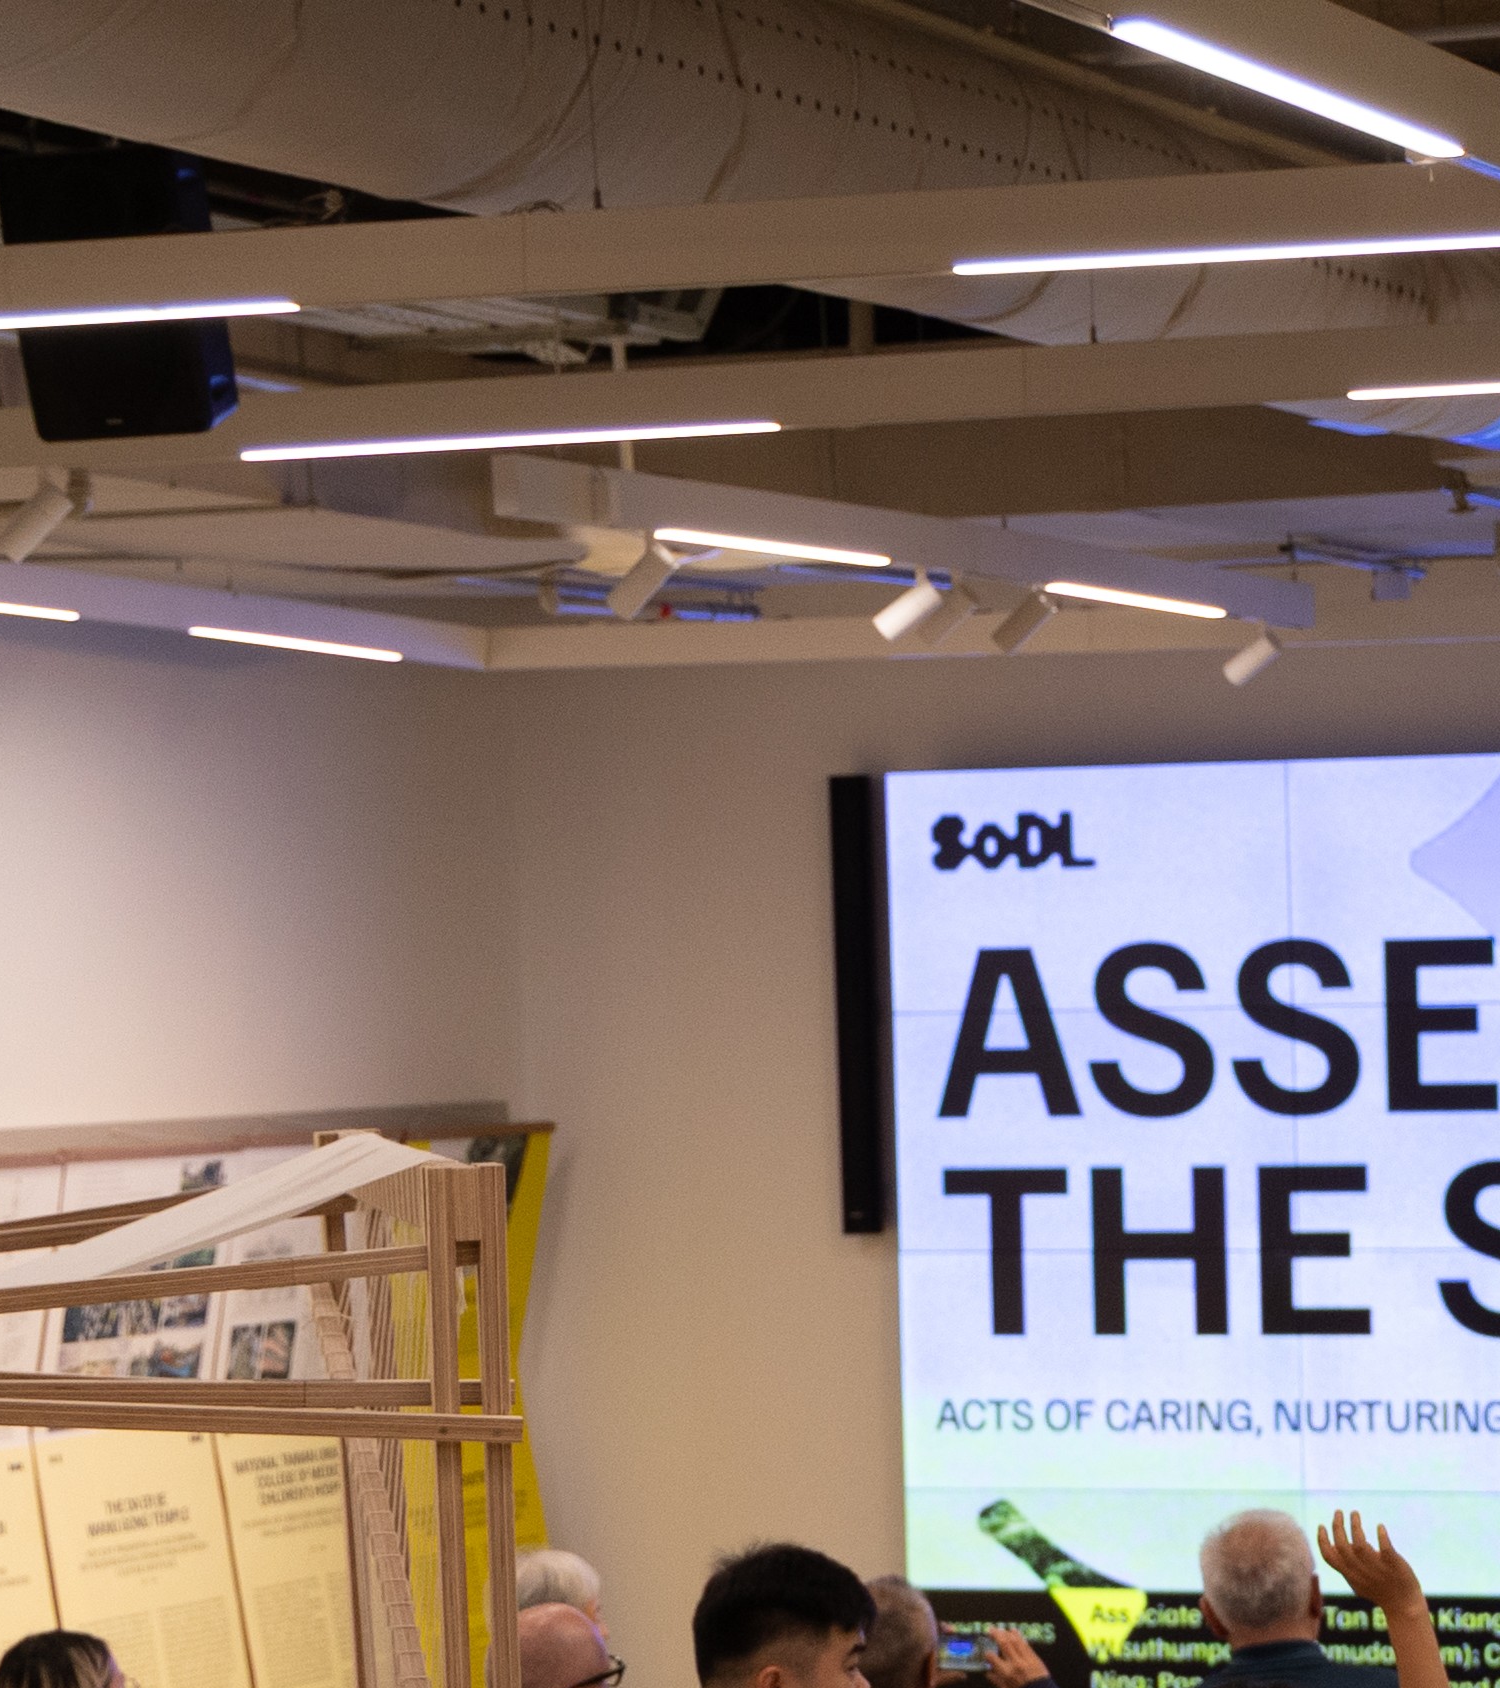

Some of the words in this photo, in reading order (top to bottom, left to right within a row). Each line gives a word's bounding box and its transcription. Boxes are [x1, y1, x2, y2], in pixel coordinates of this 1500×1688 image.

[943, 1165, 1372, 1337] THE
[936, 1398, 1034, 1432] ACTS
[1044, 1397, 1095, 1432] OF
[1104, 1399, 1262, 1438] CARING,
